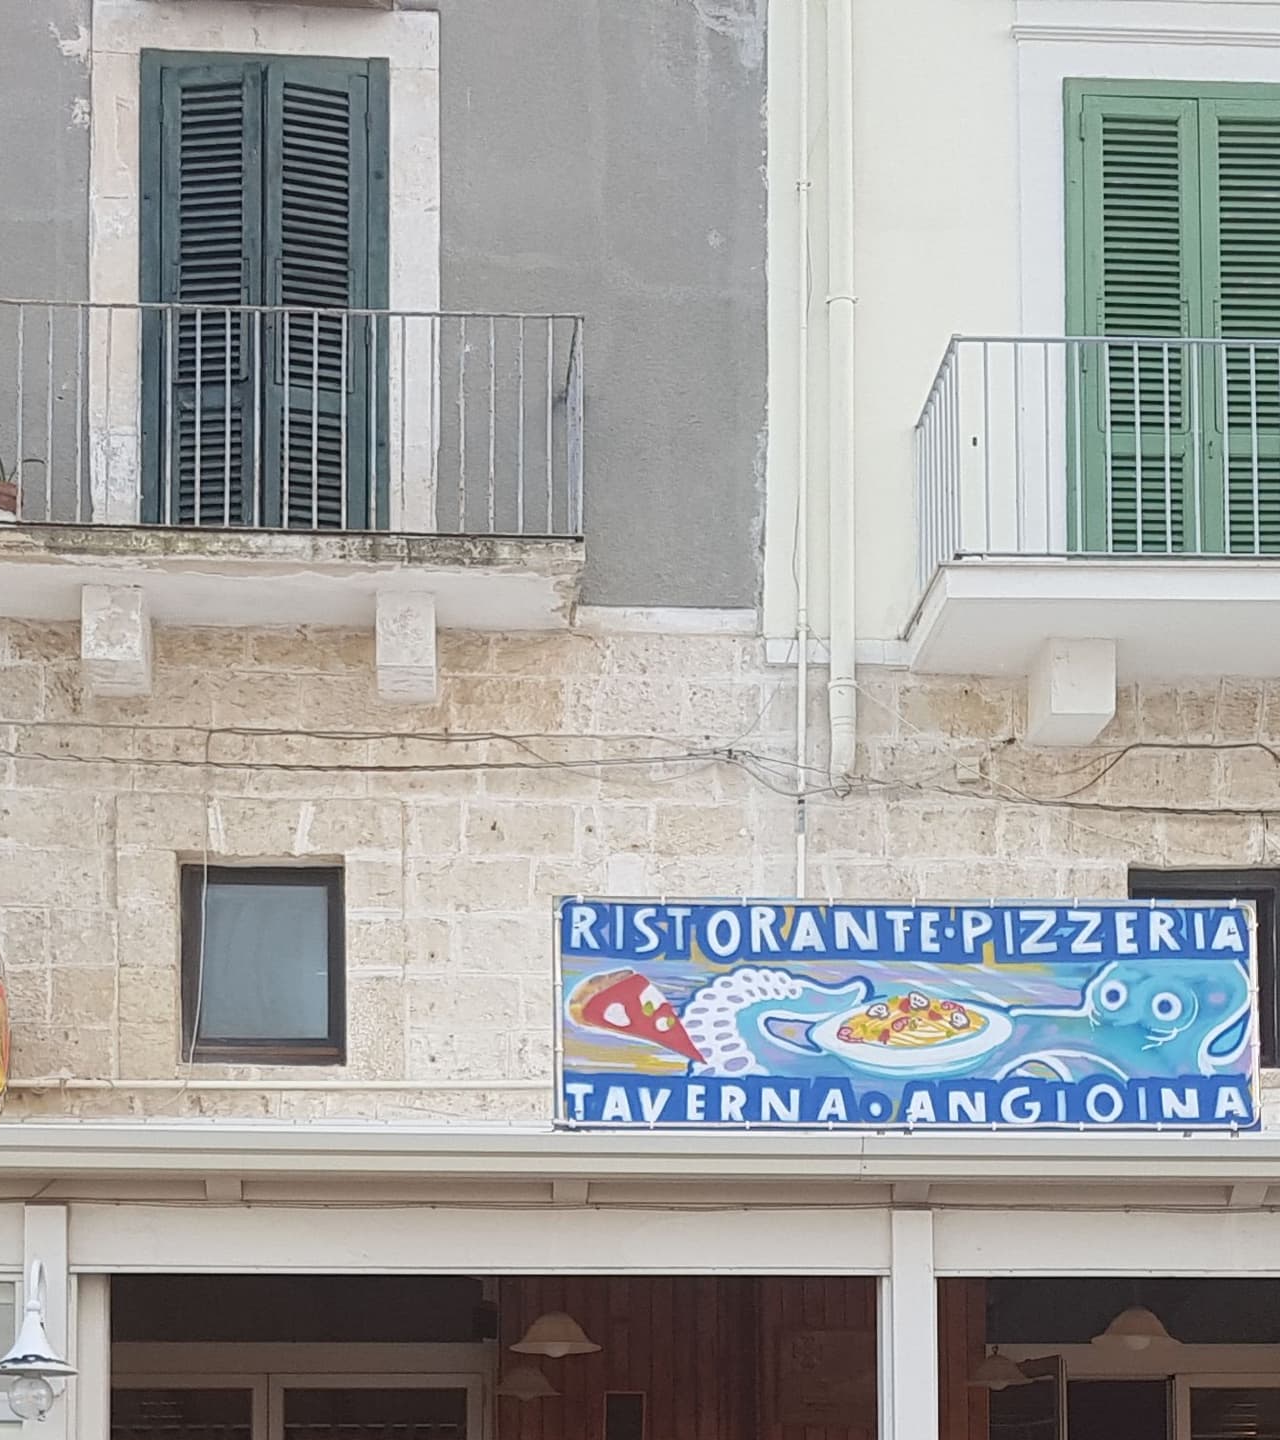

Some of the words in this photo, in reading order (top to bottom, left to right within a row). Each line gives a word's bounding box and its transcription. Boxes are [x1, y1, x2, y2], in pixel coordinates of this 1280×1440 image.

[570, 905, 940, 957] RISTORANTE
[962, 909, 1245, 956] PIZZERIA
[566, 1083, 854, 1122] TAVERNA
[907, 1083, 1248, 1123] ANGIOINA
